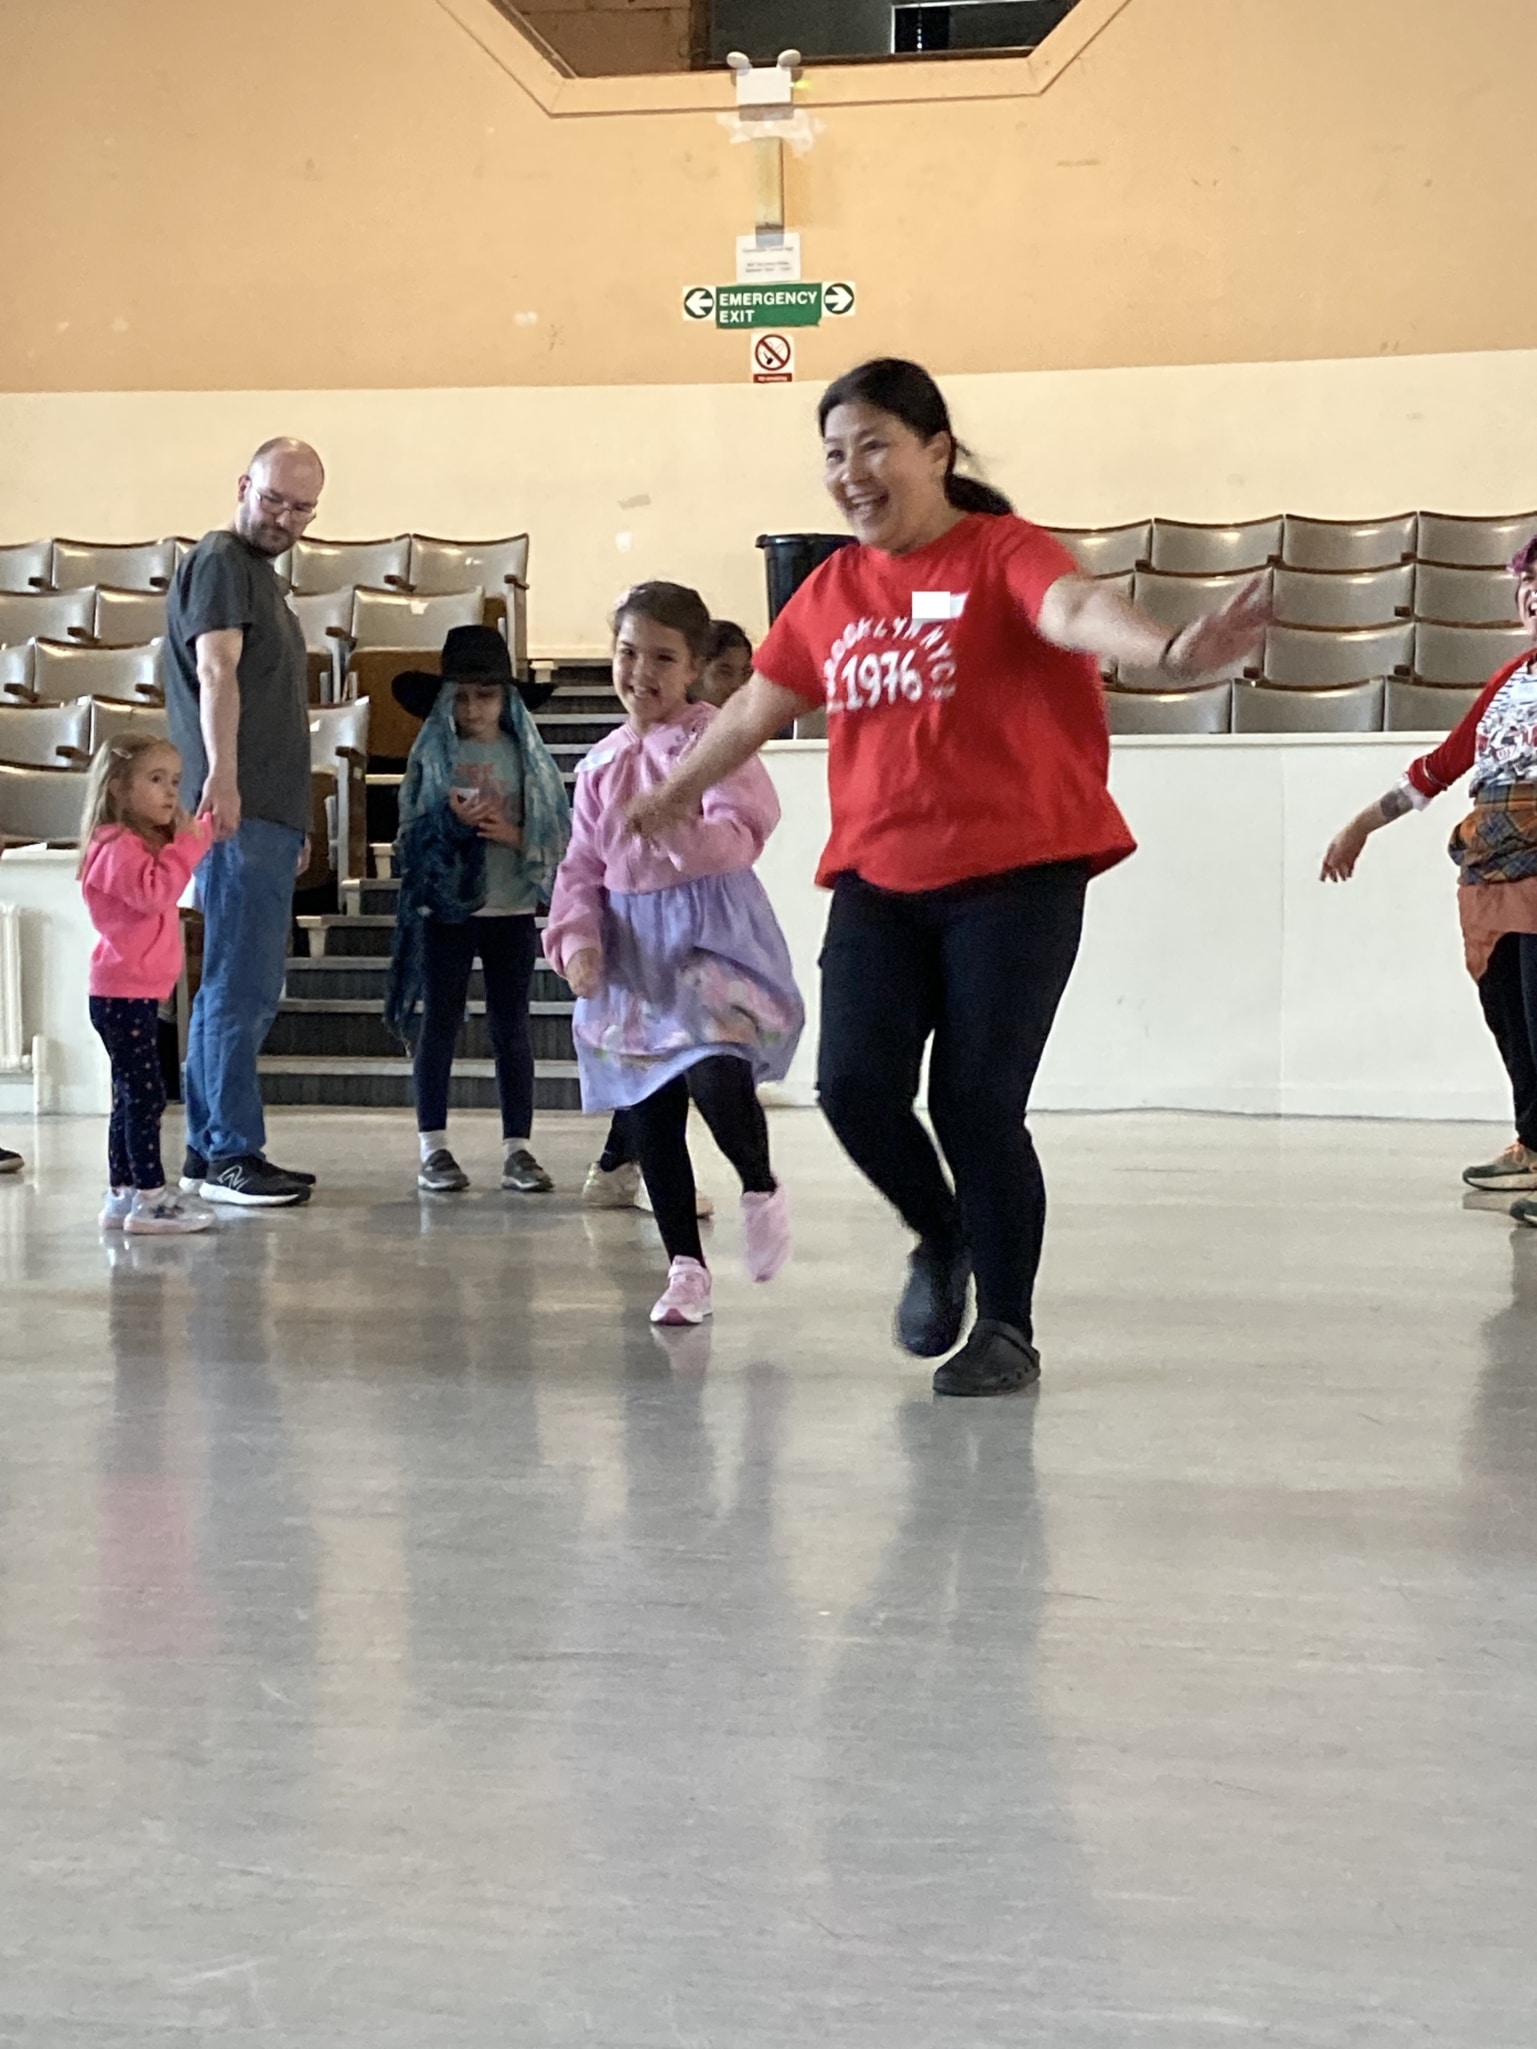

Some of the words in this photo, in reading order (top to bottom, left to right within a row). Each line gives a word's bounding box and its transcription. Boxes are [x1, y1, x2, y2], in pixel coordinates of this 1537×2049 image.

[719, 292, 817, 306] EMERGENCY
[719, 310, 755, 323] EXIT
[841, 649, 923, 709] 1976
